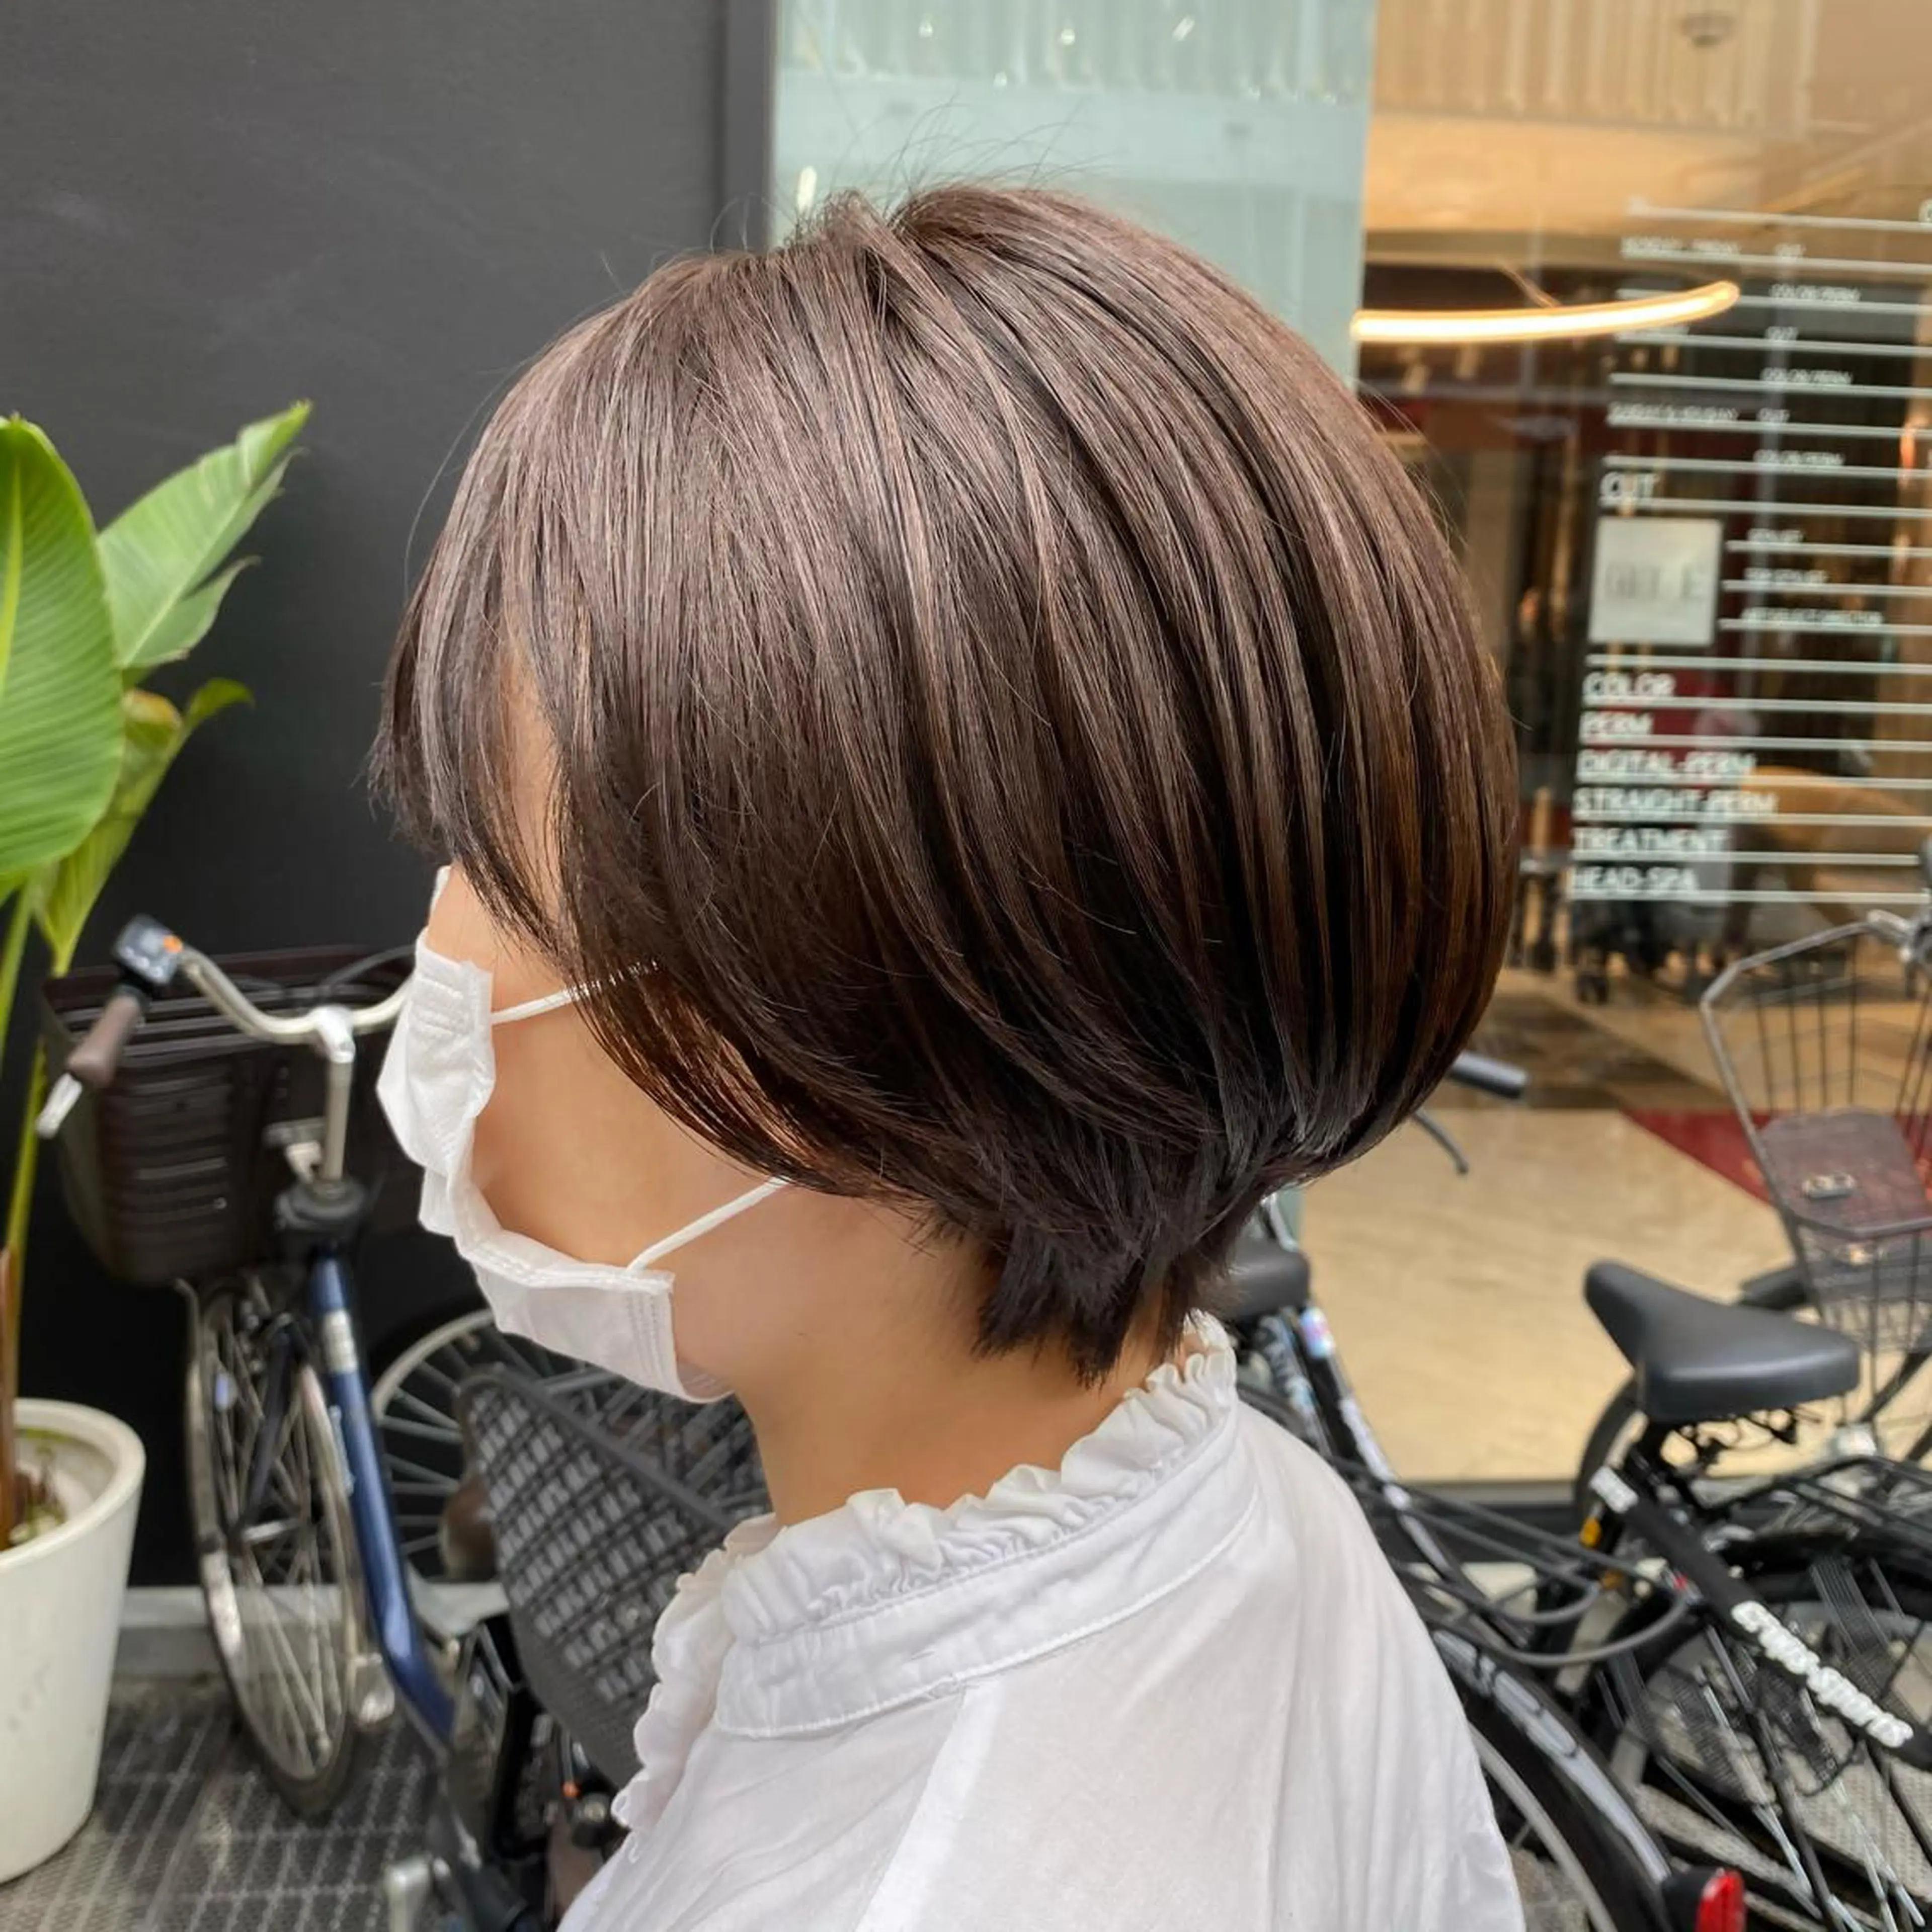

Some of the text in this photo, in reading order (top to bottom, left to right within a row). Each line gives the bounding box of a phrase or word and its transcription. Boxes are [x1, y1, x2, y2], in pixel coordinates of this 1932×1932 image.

[1582, 672, 1676, 697] COLOR
[1579, 711, 1654, 737] PERM
[1570, 827, 1730, 852] TREATMENT
